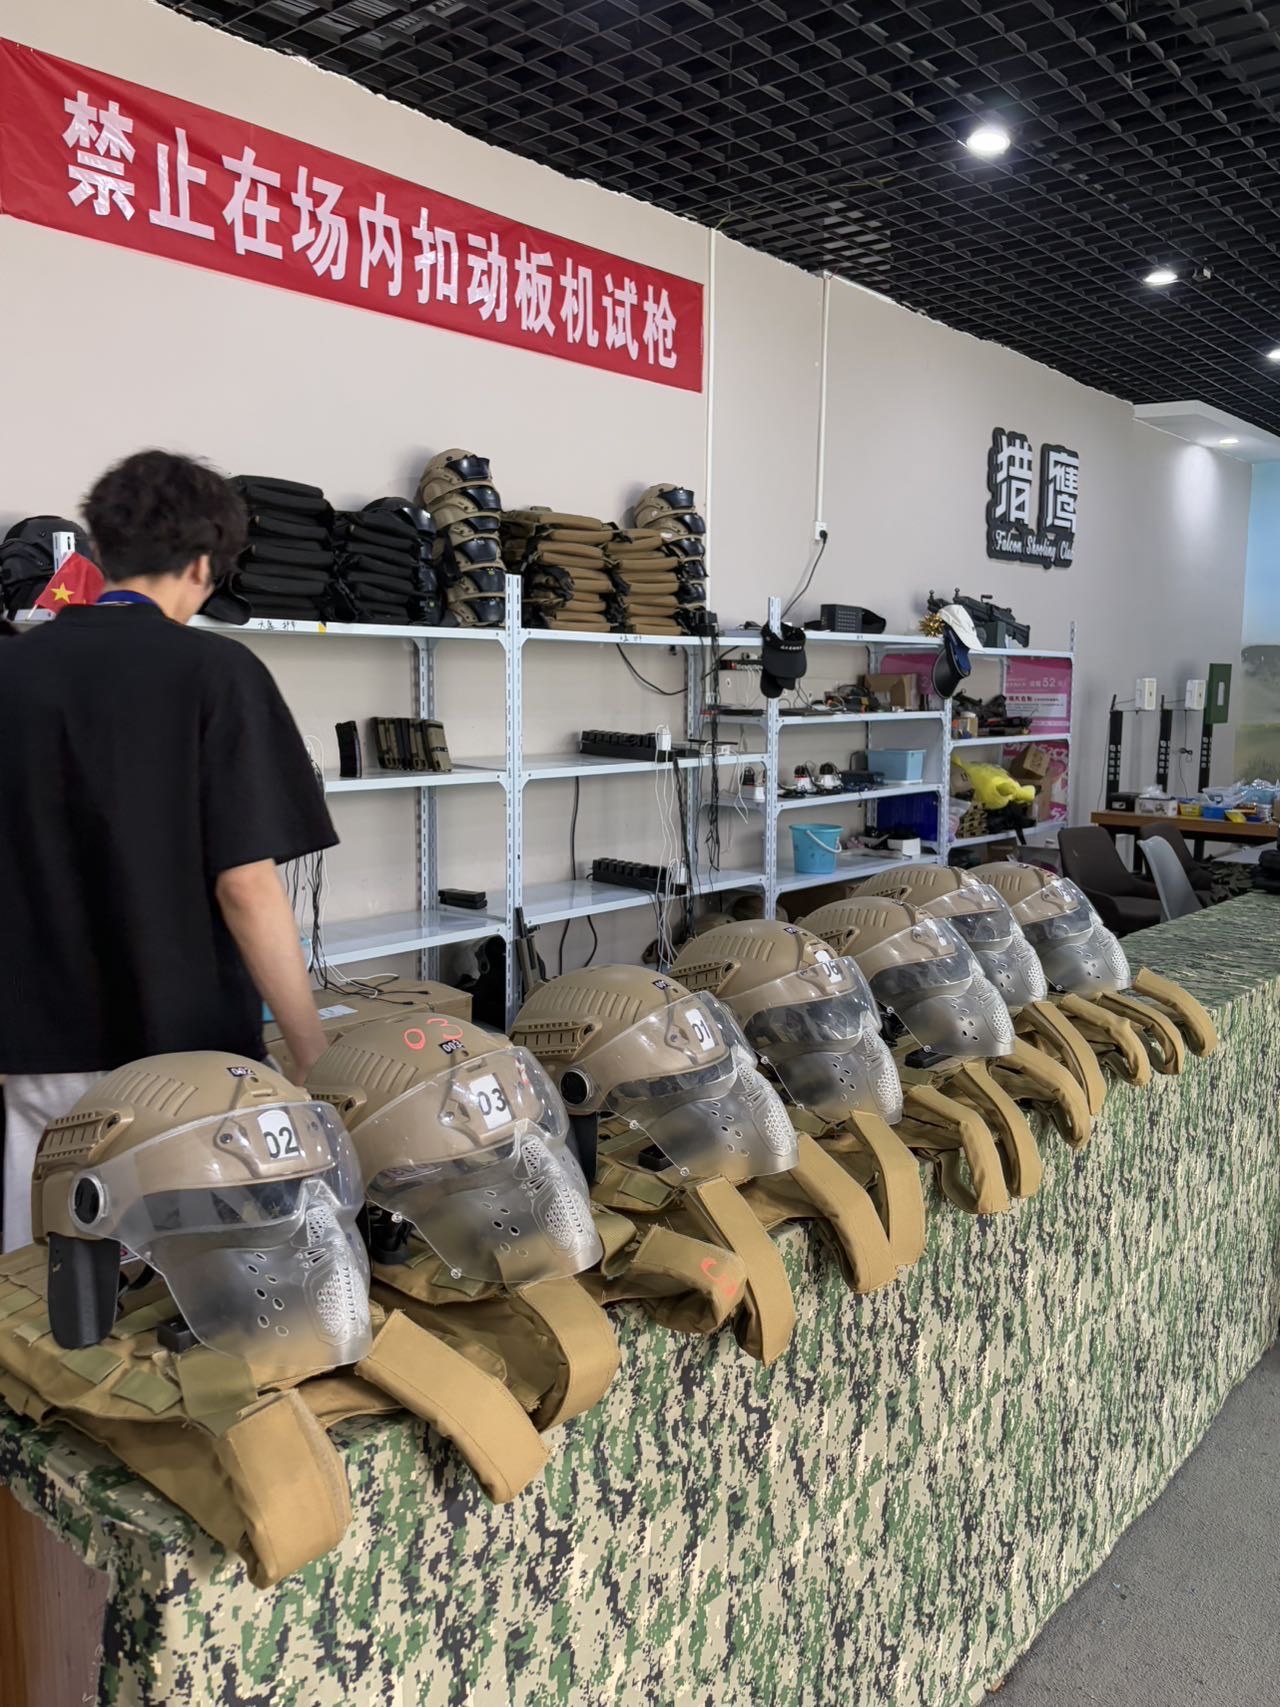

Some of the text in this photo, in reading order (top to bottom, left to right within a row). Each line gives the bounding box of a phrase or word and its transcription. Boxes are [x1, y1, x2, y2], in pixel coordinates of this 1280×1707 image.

[62, 90, 677, 369] 禁止在场内扣动板机试枪
[995, 530, 1074, 562] Falcon Shooting Clu
[403, 1018, 464, 1050] 03
[692, 1020, 711, 1042] 01
[477, 1087, 507, 1116] 03
[263, 1126, 300, 1159] 02
